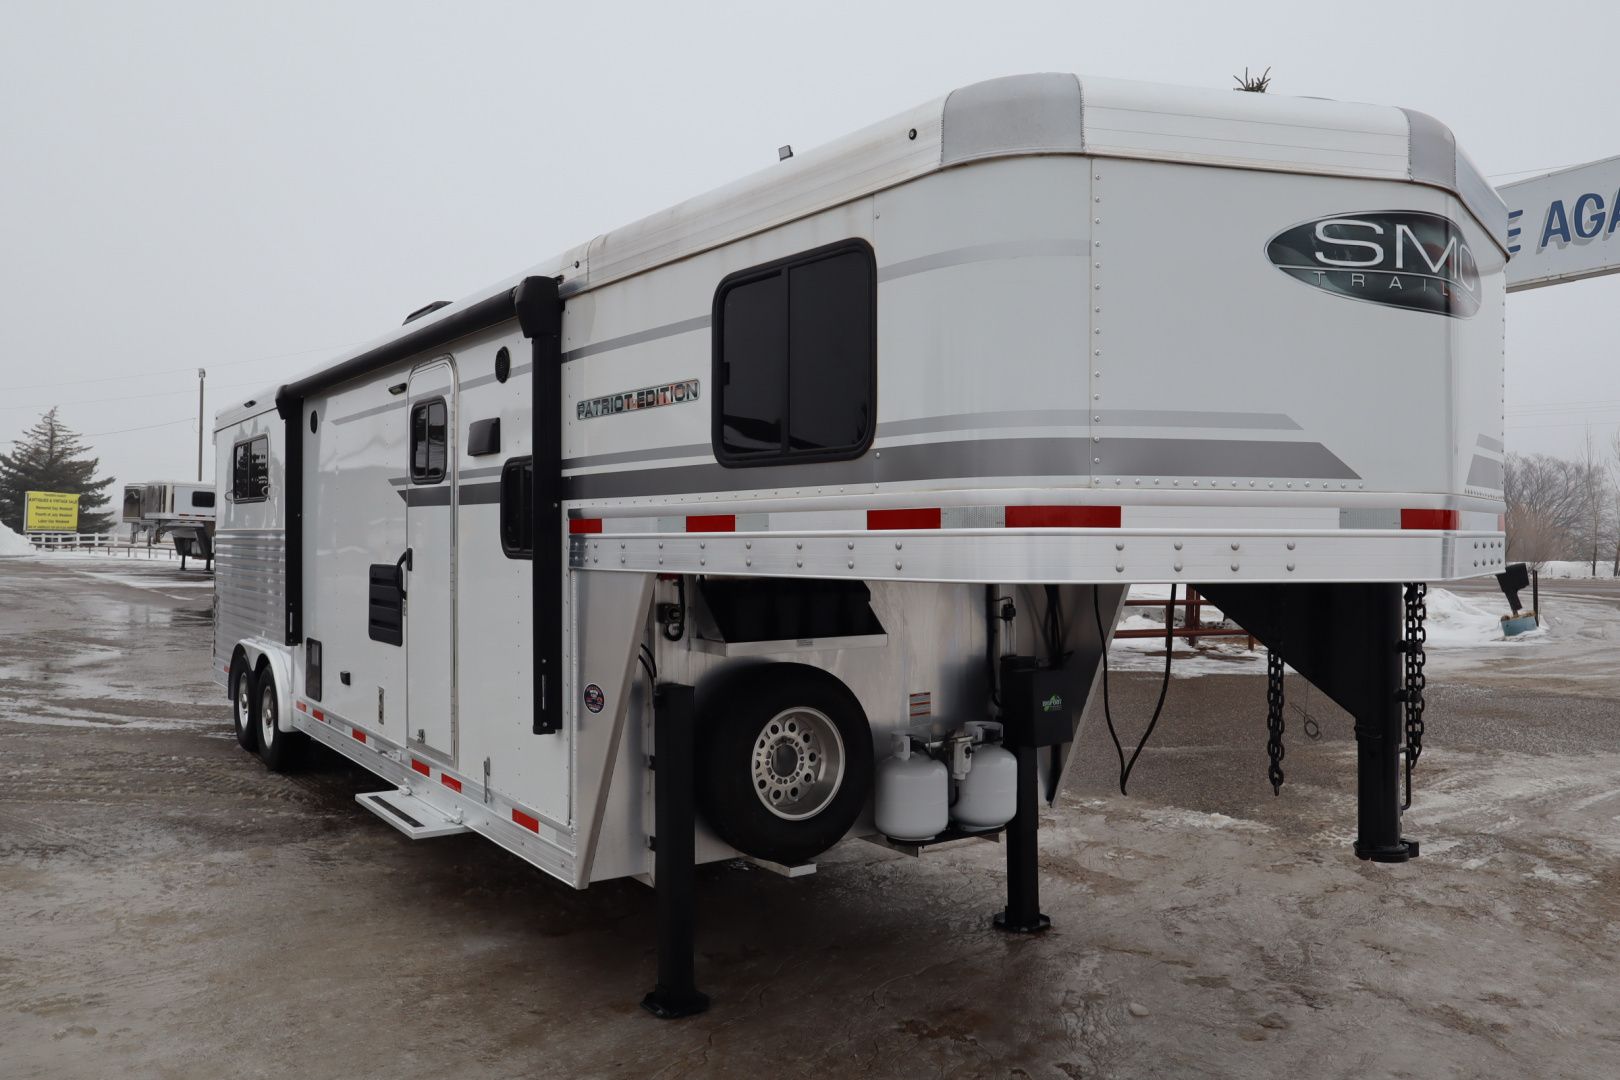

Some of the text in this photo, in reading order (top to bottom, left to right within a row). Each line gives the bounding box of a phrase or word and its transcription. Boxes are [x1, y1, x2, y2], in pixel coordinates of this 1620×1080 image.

[1315, 218, 1474, 292] SMC
[577, 382, 698, 418] PATRIOT EDITION
